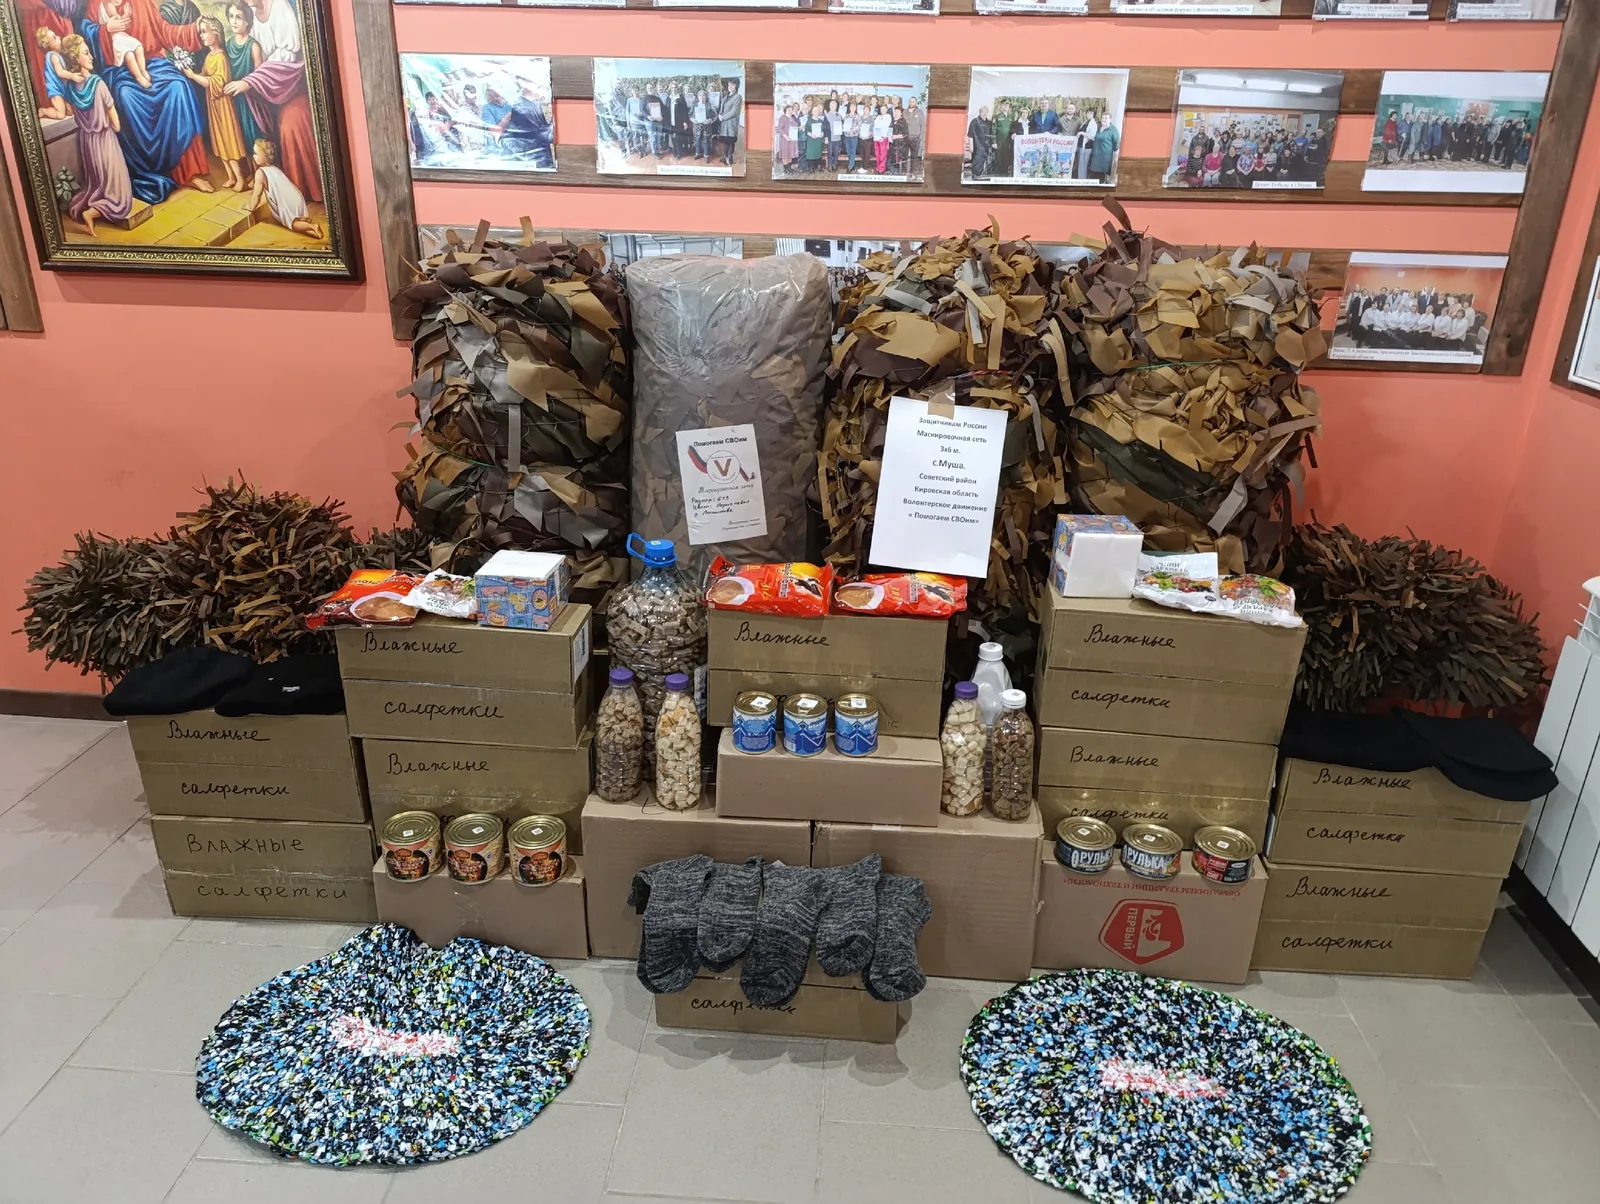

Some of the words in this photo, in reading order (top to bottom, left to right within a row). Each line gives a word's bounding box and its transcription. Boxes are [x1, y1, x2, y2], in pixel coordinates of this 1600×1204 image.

[919, 417, 962, 428] Защитникам
[963, 422, 988, 430] России
[693, 439, 724, 447] Помогаем
[916, 430, 971, 442] Маскировочная
[919, 473, 955, 482] Советский
[914, 486, 951, 495] Кировская
[952, 490, 979, 498] область
[903, 498, 951, 508] Волонтерское
[952, 503, 988, 512] движение
[914, 512, 950, 522] Помогаем
[360, 631, 464, 654] Влажные
[733, 621, 829, 646] Влажные
[1083, 623, 1176, 649] Влажные
[1071, 689, 1171, 709] салфетки
[384, 700, 504, 721] салфетки
[166, 720, 271, 742] Влажные
[386, 752, 490, 776] Влажные
[1069, 745, 1160, 767] Влажные
[1312, 767, 1412, 790] Влажные
[181, 781, 290, 799] салфетки
[1127, 845, 1165, 870] РУЛЬКА
[197, 884, 348, 901] салфетки
[1285, 875, 1392, 898] Влажные
[1122, 907, 1138, 950] ПЕРВЫЙ
[1281, 935, 1393, 954] салфетки
